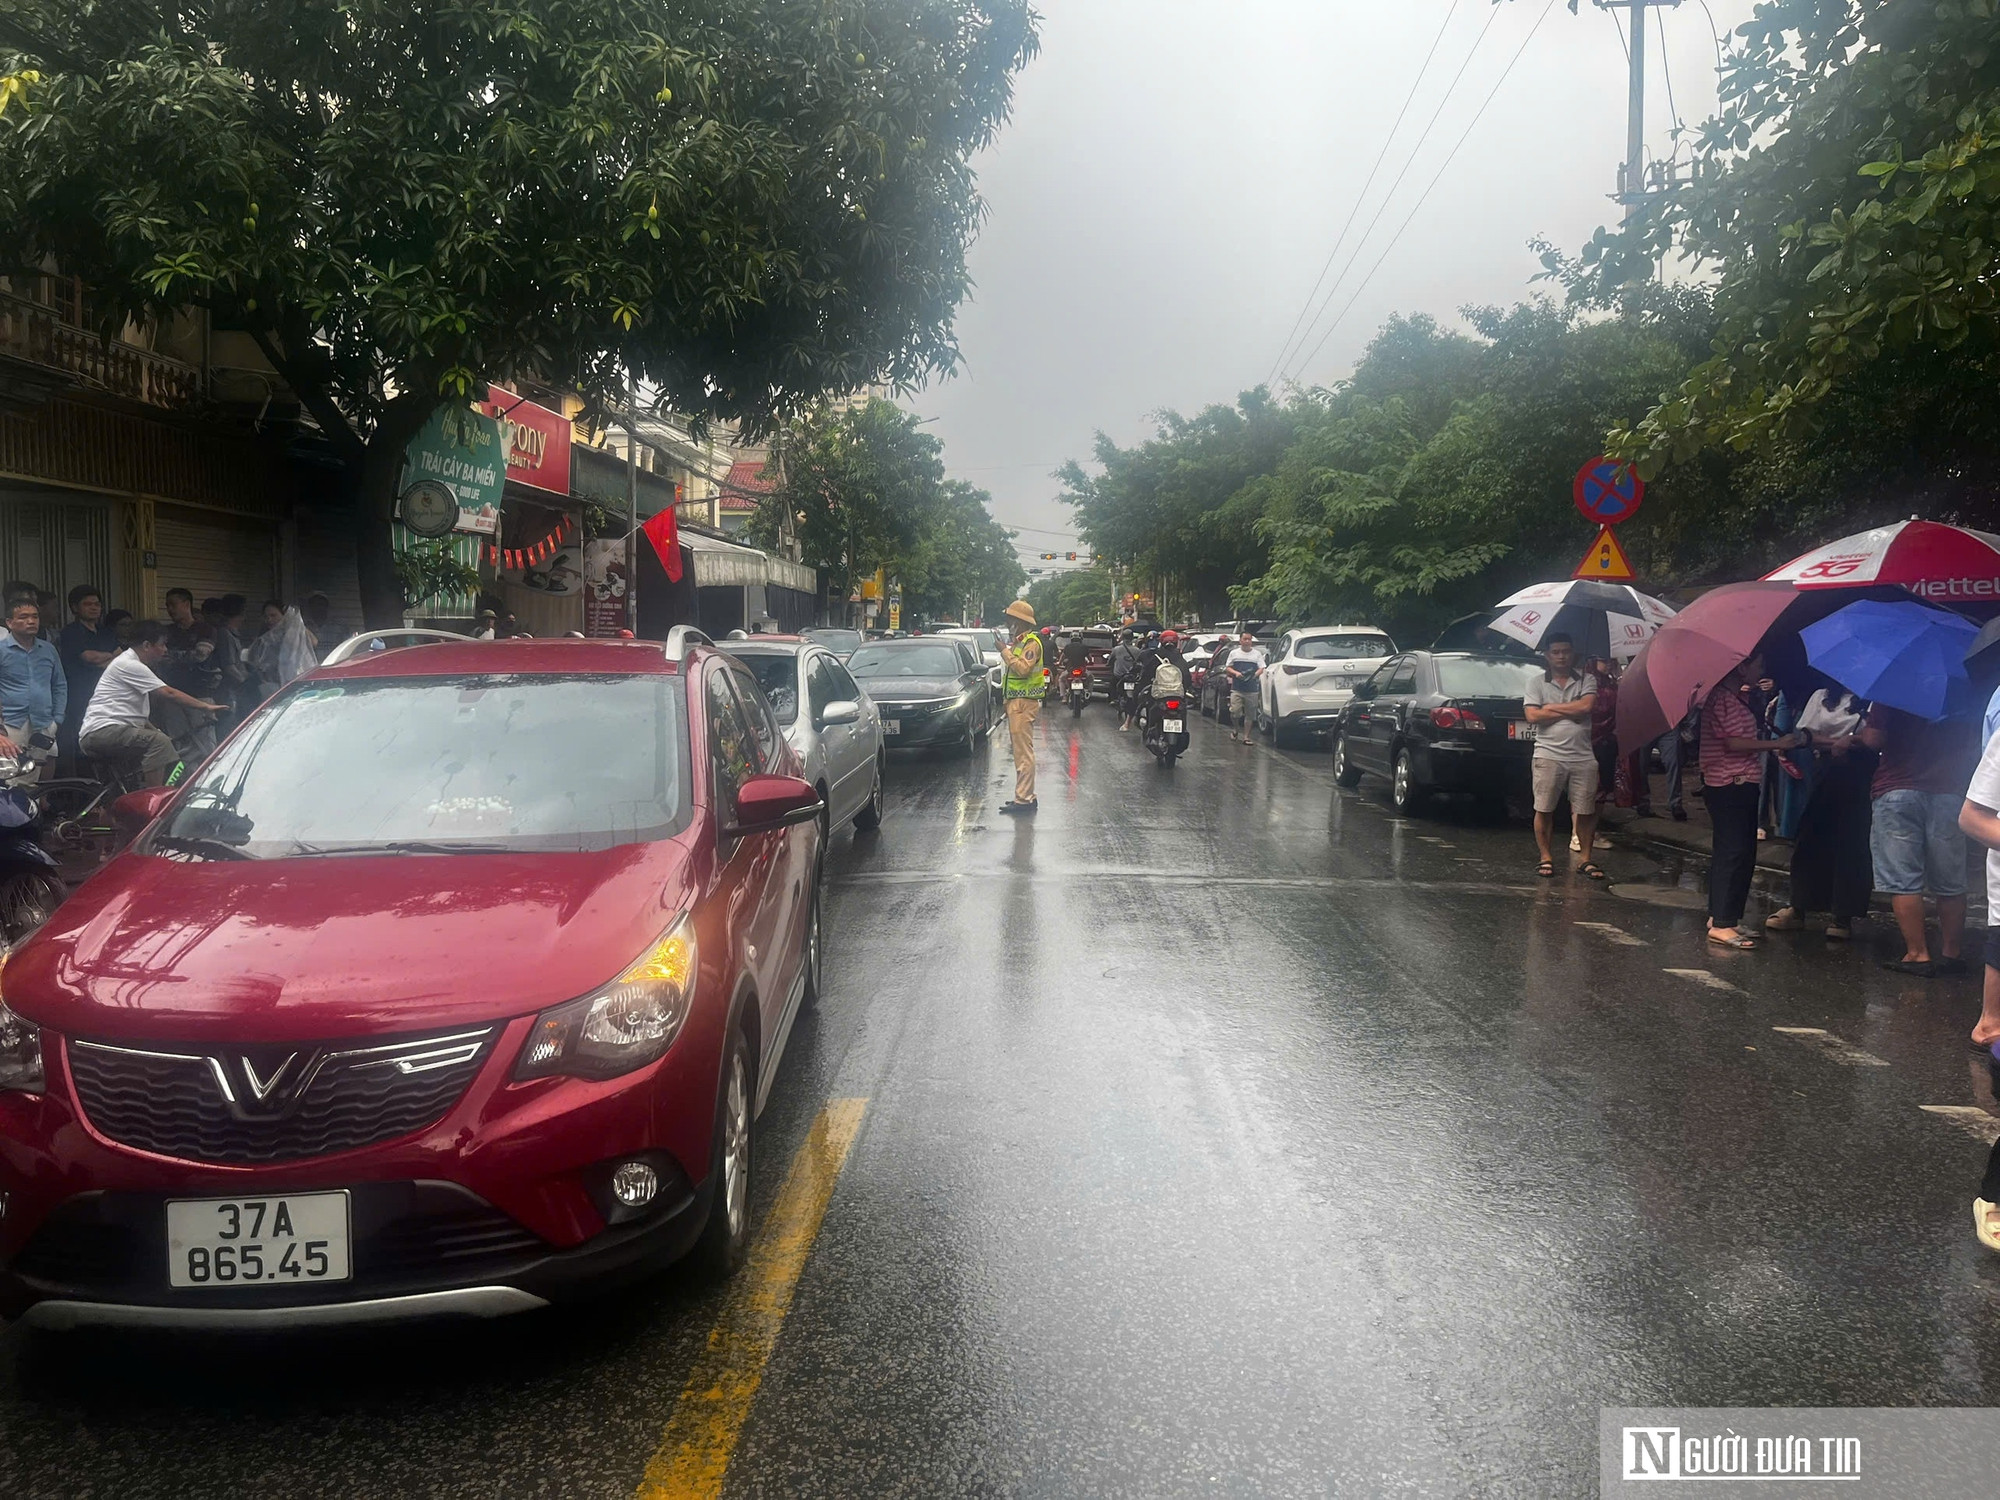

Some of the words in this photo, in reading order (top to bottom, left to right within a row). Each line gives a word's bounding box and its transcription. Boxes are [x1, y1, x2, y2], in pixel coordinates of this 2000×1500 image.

[421, 450, 443, 474] TRÁI
[443, 455, 462, 479] CÂY
[462, 463, 475, 482] BA
[508, 454, 531, 470] EAUTY
[471, 488, 480, 500] LIFE
[1800, 558, 1867, 578] 5G
[1901, 577, 2000, 596] viettel
[1520, 731, 1537, 740] 105
[218, 1201, 294, 1240] 37A
[187, 1241, 329, 1283] 865.45
